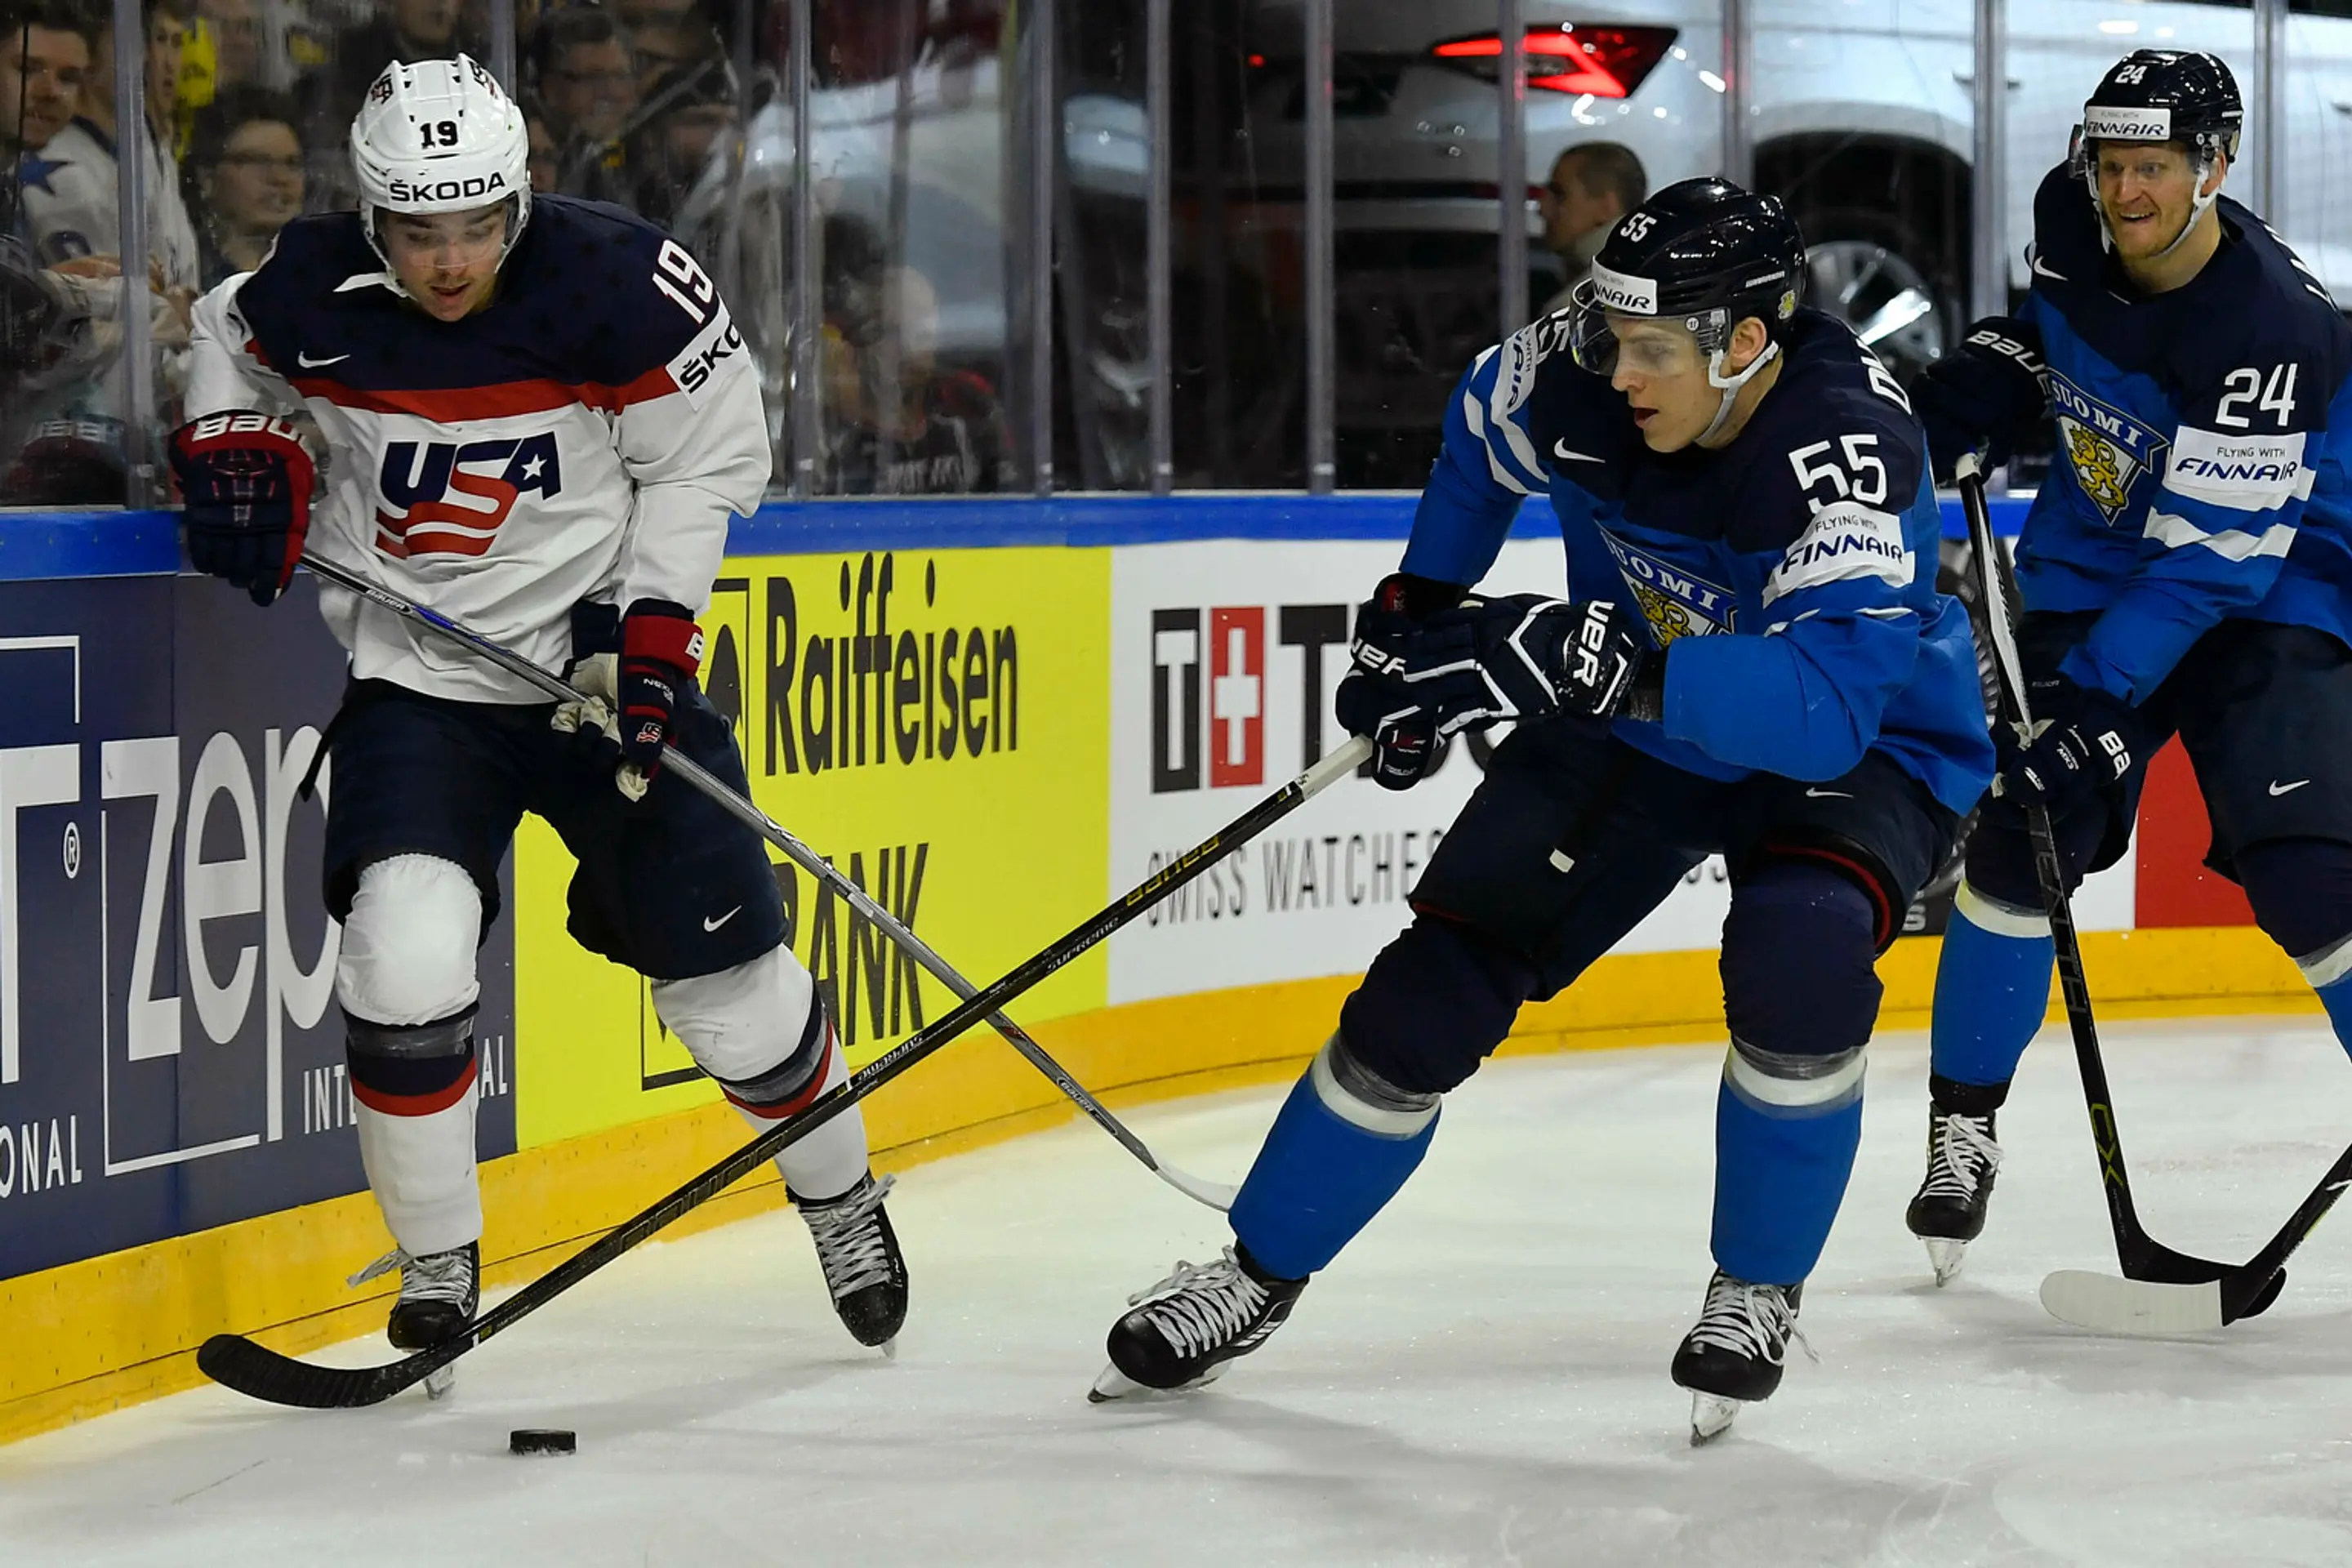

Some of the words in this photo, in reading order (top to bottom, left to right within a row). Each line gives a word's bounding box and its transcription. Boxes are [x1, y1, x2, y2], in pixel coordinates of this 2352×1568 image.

[2114, 65, 2147, 85] 24
[420, 121, 458, 149] 19
[389, 172, 506, 203] ŠKODA
[1620, 212, 1657, 243] 55
[653, 239, 714, 324] 19
[2051, 379, 2143, 448] SUOMI
[2215, 363, 2298, 428] 24
[2176, 457, 2298, 482] FINNAIR
[2216, 447, 2255, 457] FLYING
[2258, 447, 2286, 457] WITH
[1788, 434, 1887, 515] 55
[376, 430, 561, 559] USA
[1815, 514, 1860, 533] FLYING
[1780, 533, 1904, 576] FINNAIR
[764, 551, 1018, 777] Raiffeisen
